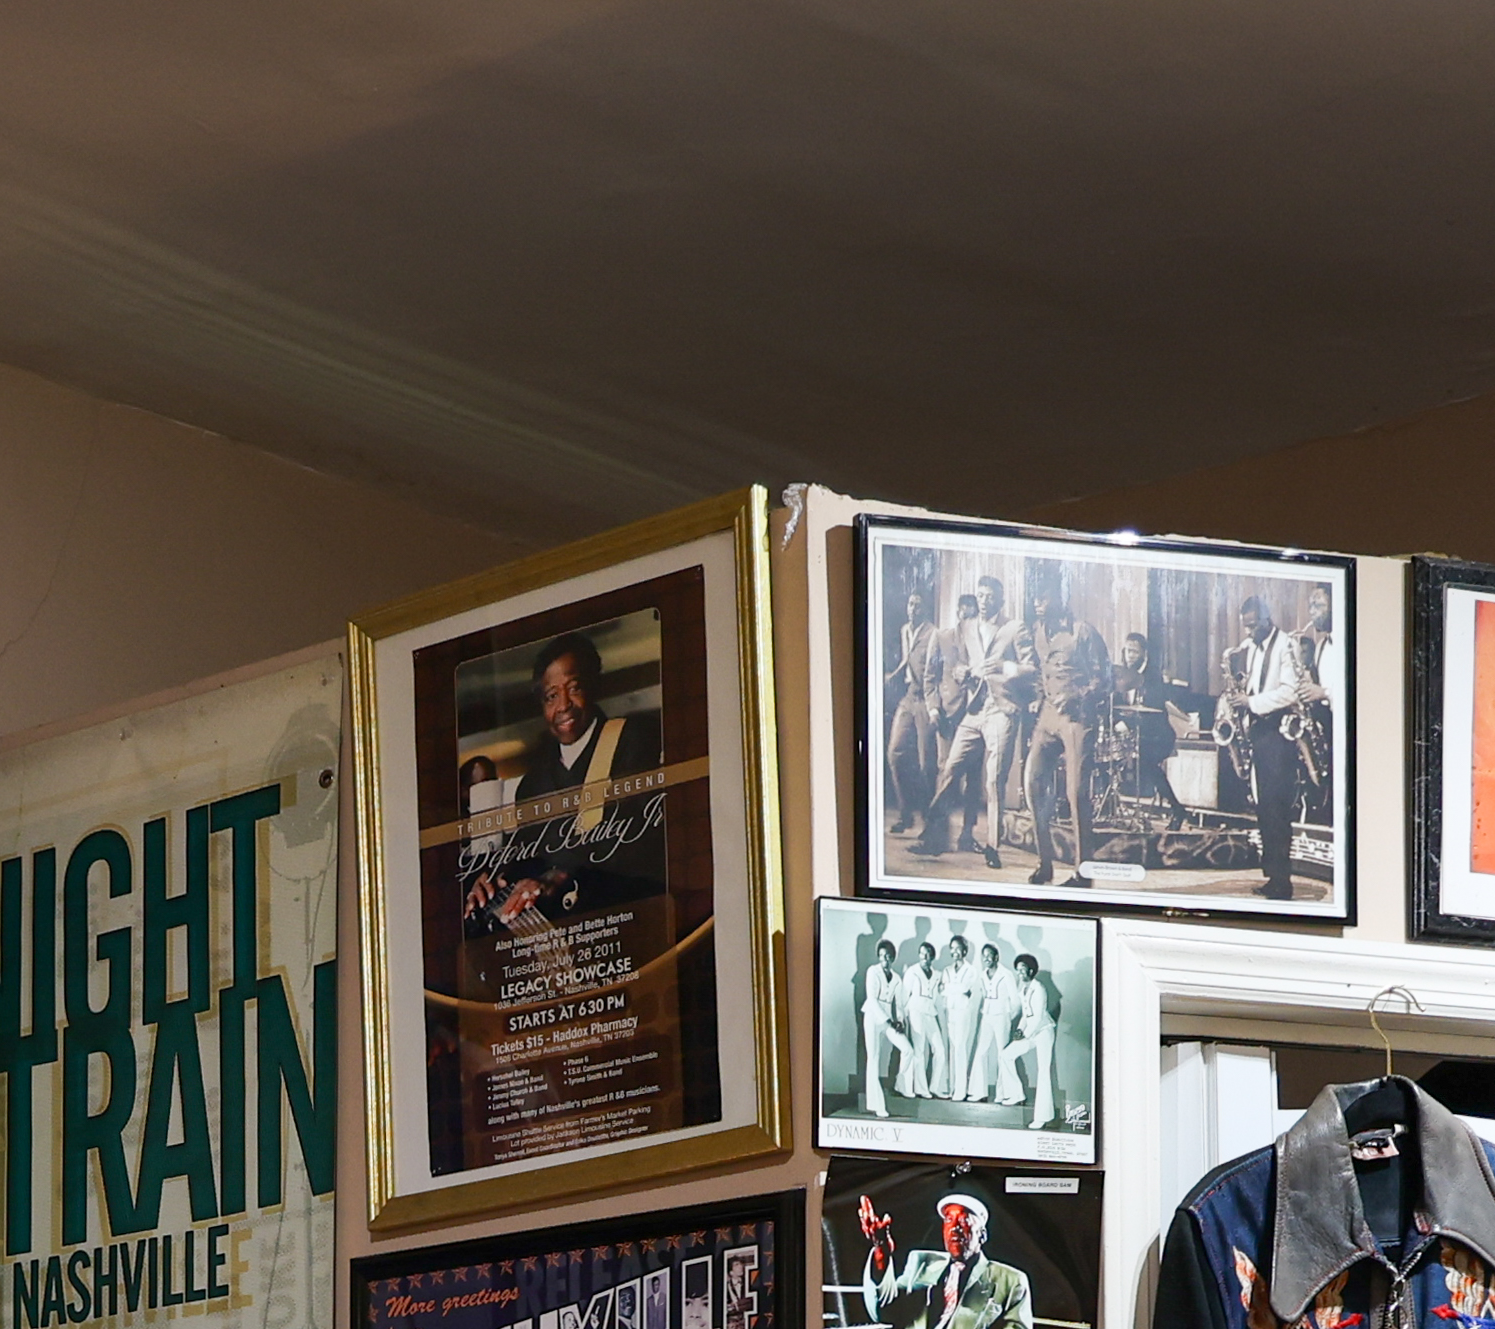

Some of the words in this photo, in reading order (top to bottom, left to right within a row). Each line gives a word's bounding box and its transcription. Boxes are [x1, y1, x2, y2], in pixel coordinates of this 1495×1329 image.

[457, 808, 523, 836] TRIBUTE
[533, 801, 552, 817] TO
[562, 791, 592, 809] R&B
[603, 772, 666, 798] LEGEND
[455, 819, 553, 884] Deford
[545, 805, 635, 863] Bailey
[500, 974, 553, 1000] LEGACY
[555, 957, 633, 988] SHOWCASE
[509, 1008, 556, 1032] STARTS
[559, 1004, 575, 1021] AT
[578, 999, 605, 1017] 630
[607, 993, 626, 1011] PM
[826, 1123, 885, 1141] DYNAMIC
[385, 1294, 436, 1319] More
[441, 1285, 521, 1316] greetings
